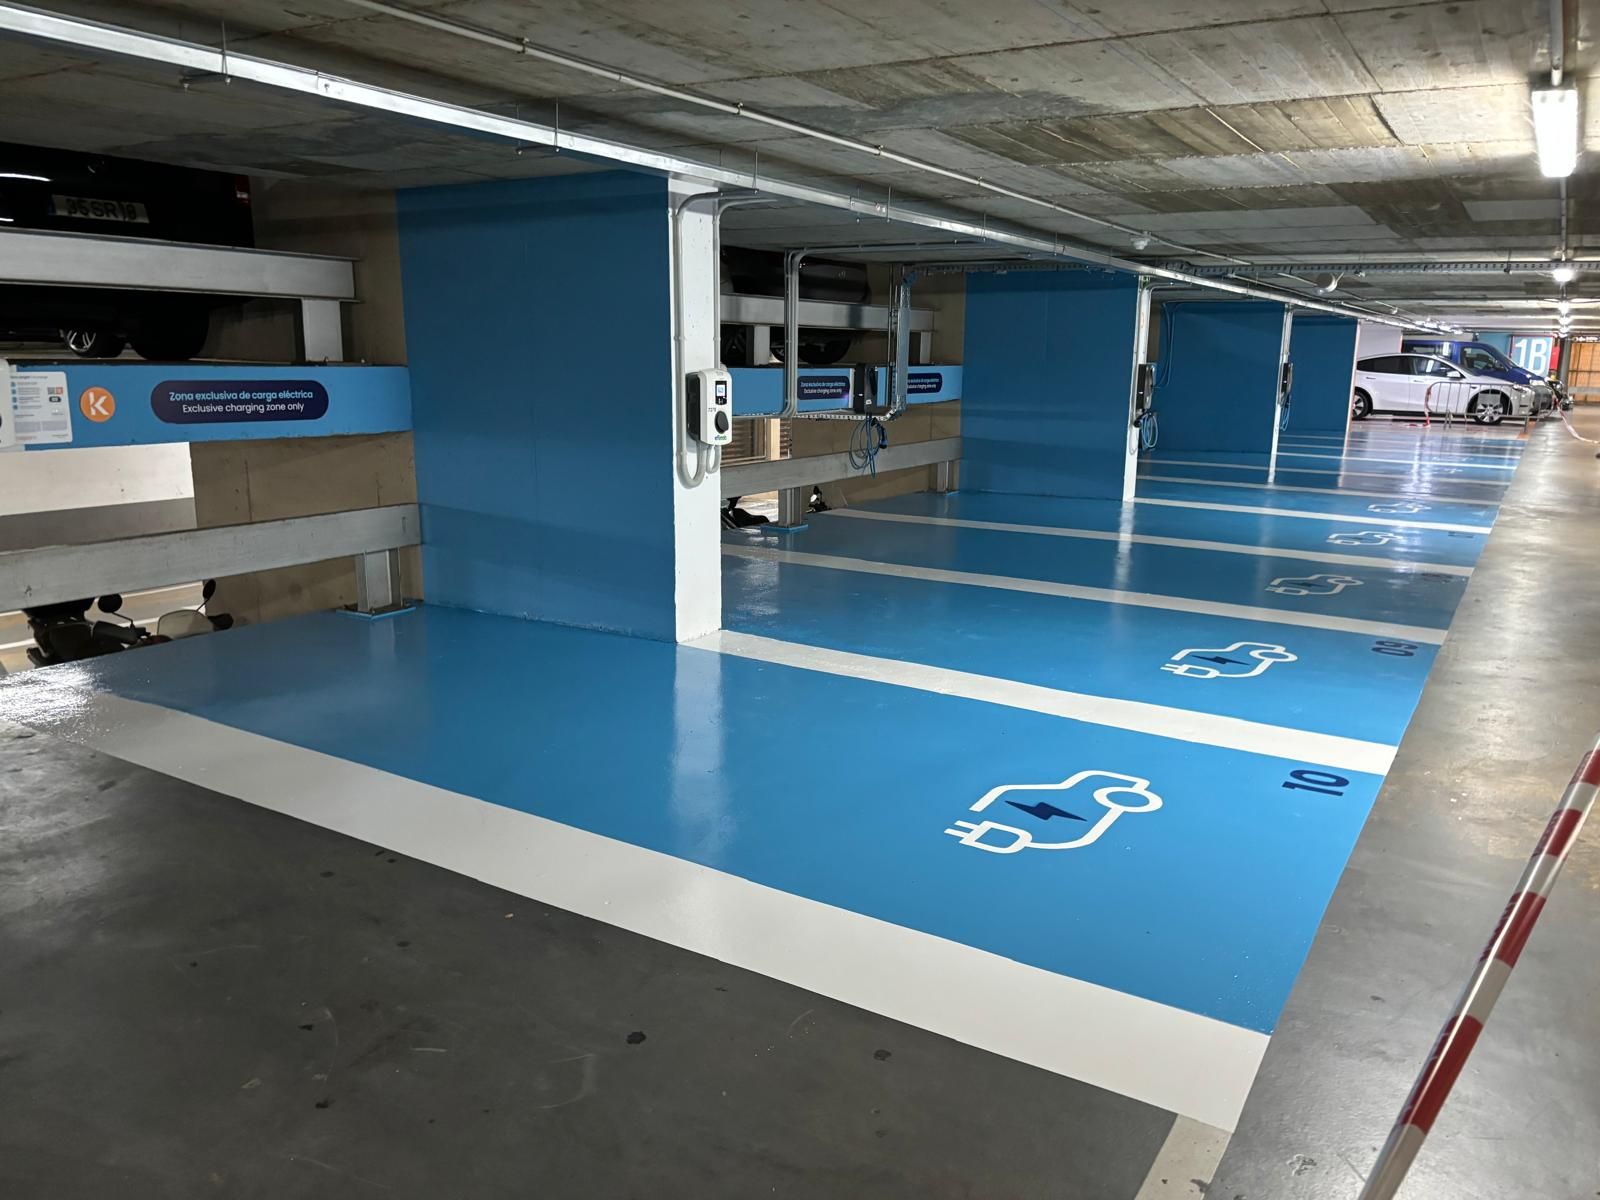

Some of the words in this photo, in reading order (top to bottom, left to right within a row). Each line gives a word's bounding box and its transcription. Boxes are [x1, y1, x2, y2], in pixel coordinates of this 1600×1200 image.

[1515, 338, 1548, 376] 1B
[88, 391, 110, 416] K
[169, 391, 194, 401] Zona
[195, 390, 238, 400] exclusiva
[238, 390, 251, 400] de
[251, 392, 276, 402] carga
[278, 389, 313, 399] eléctrica
[182, 403, 224, 413] Exclusive
[225, 402, 265, 414] charging
[265, 403, 286, 411] zone
[287, 401, 305, 412] only
[1281, 769, 1349, 797] 10
